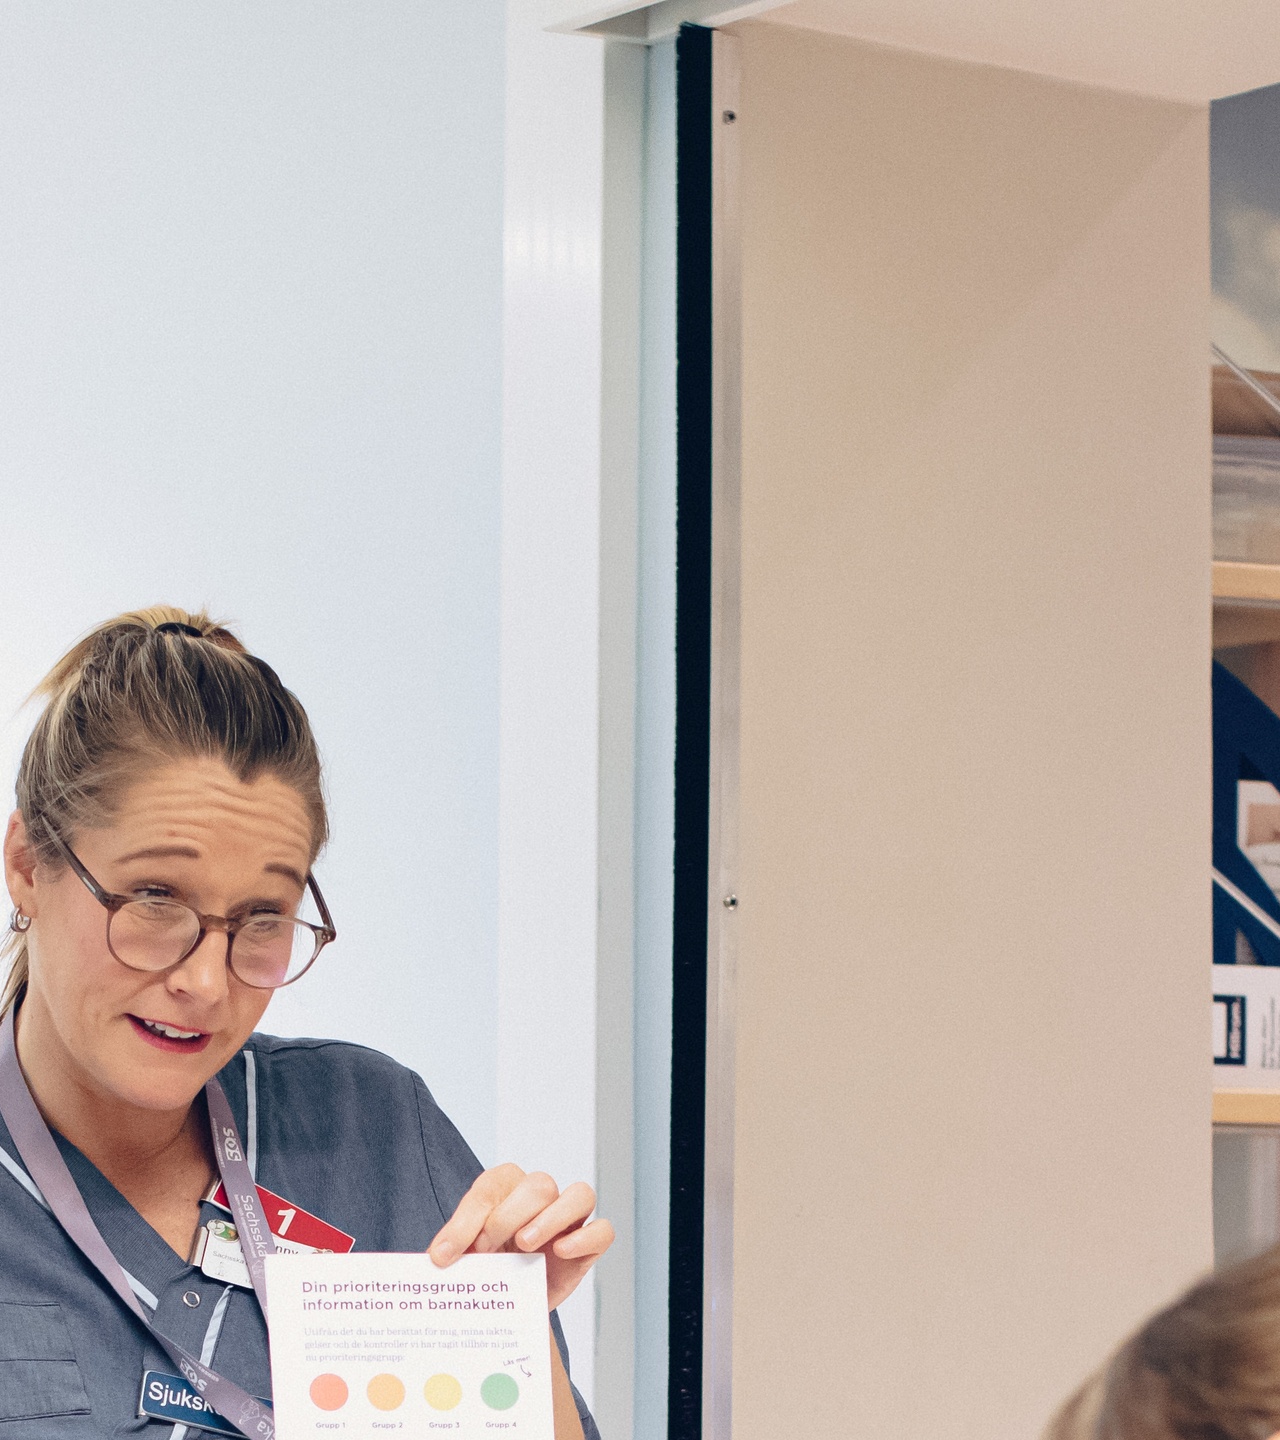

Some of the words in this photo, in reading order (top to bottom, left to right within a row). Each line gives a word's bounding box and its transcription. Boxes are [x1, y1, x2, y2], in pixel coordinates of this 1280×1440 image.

[240, 1194, 267, 1257] Sachsska
[277, 1208, 297, 1236] 1
[302, 1281, 327, 1293] Din
[333, 1281, 475, 1295] prioriteringsgrupp
[481, 1281, 508, 1292] och
[303, 1299, 394, 1310] information
[399, 1301, 423, 1310] om
[428, 1299, 515, 1310] barnakuten
[148, 1381, 222, 1416] Sjuksk
[316, 1422, 340, 1430] Grupp
[429, 1421, 453, 1429] Grupp
[486, 1421, 510, 1429] Grupp
